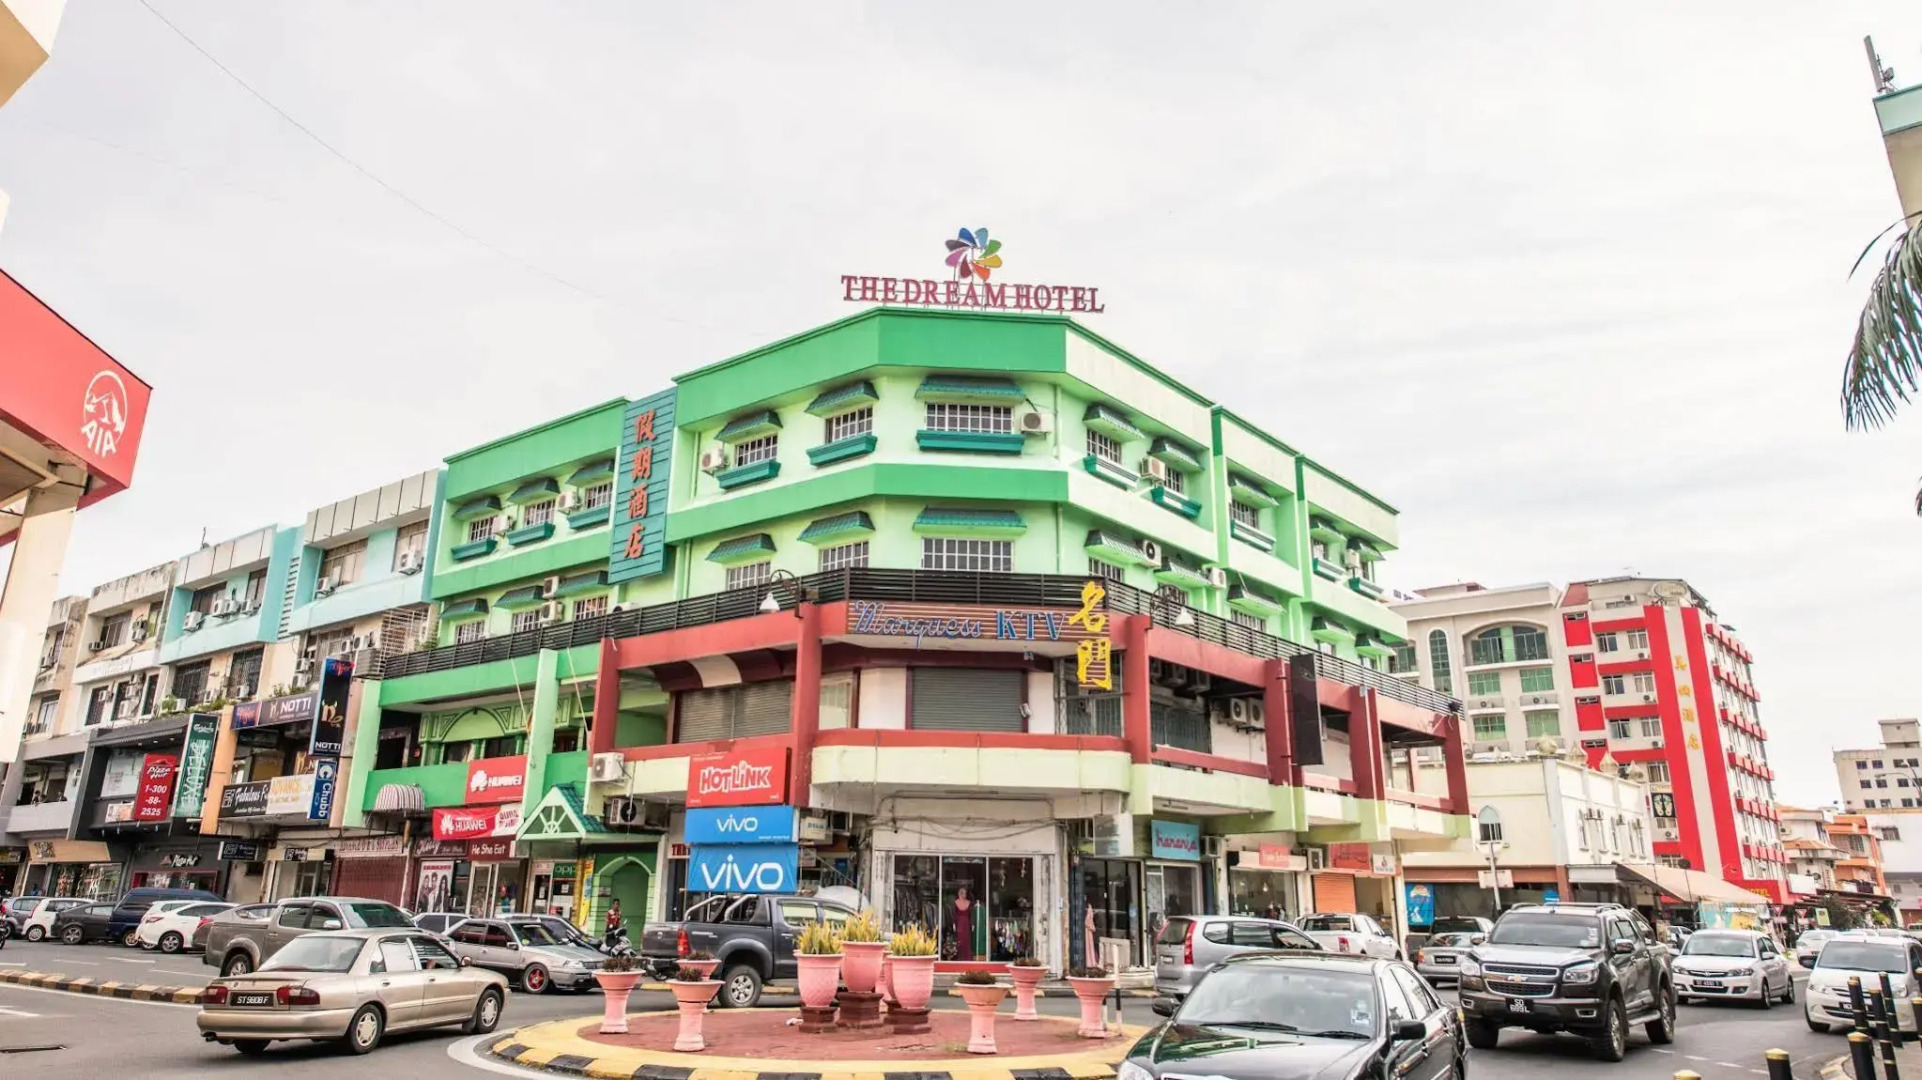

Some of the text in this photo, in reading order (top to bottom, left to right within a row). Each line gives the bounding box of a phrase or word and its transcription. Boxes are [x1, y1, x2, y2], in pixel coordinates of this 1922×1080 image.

[841, 275, 1105, 313] THE DREAM HOTEL
[80, 420, 117, 459] AIA
[624, 410, 657, 559] 假期酒店
[853, 600, 1067, 650] Marquess KTV
[280, 697, 312, 713] NOTTI
[145, 785, 167, 794] 1-300
[487, 774, 523, 787] HUAWEI
[318, 782, 332, 818] Chubb
[454, 818, 488, 832] HUAWEI
[716, 814, 759, 832] vivo
[472, 844, 480, 854] He
[481, 844, 493, 855] She
[701, 854, 784, 890] vivo
